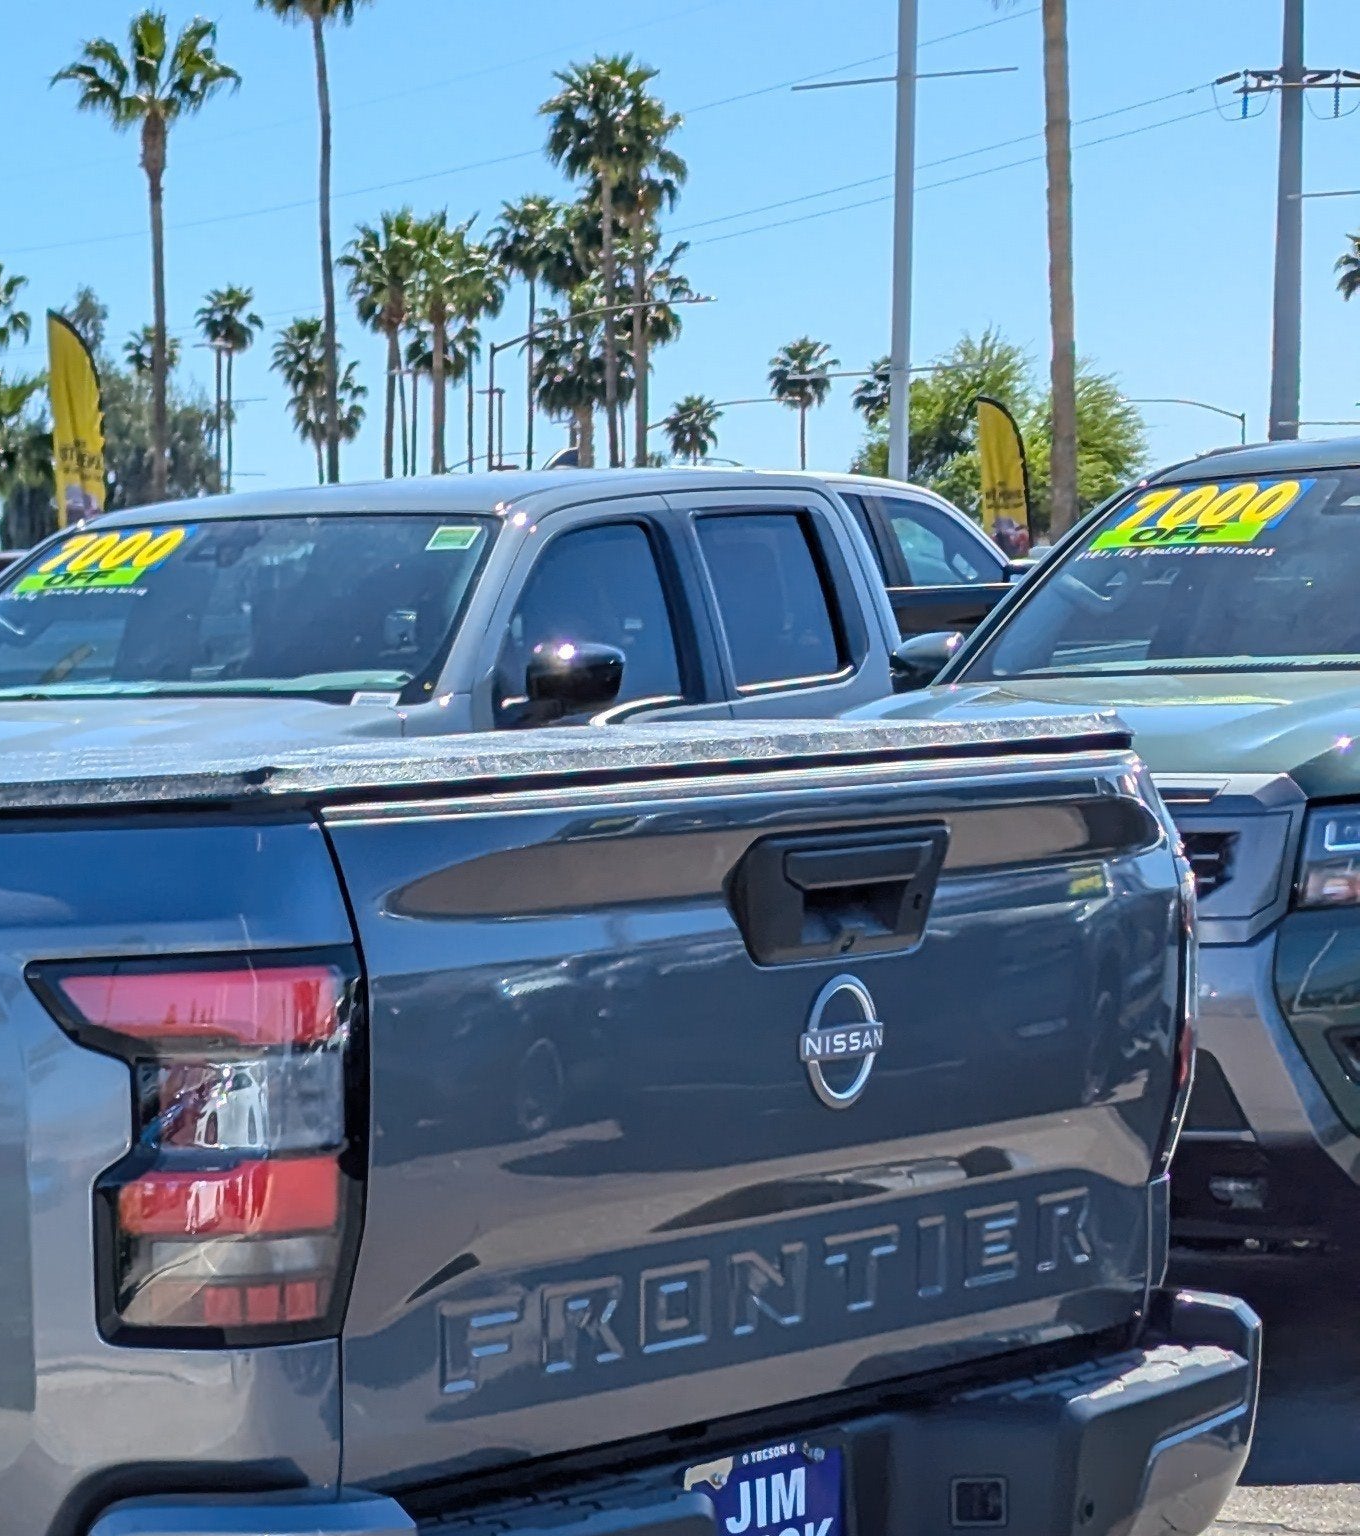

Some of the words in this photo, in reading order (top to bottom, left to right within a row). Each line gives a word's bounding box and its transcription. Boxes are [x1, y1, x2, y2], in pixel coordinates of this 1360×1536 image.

[1128, 524, 1227, 542] OFF
[43, 569, 116, 586] OFF
[805, 1028, 883, 1056] NISSAN
[438, 1186, 1091, 1394] FRONTIER
[725, 1466, 806, 1534] JIM
